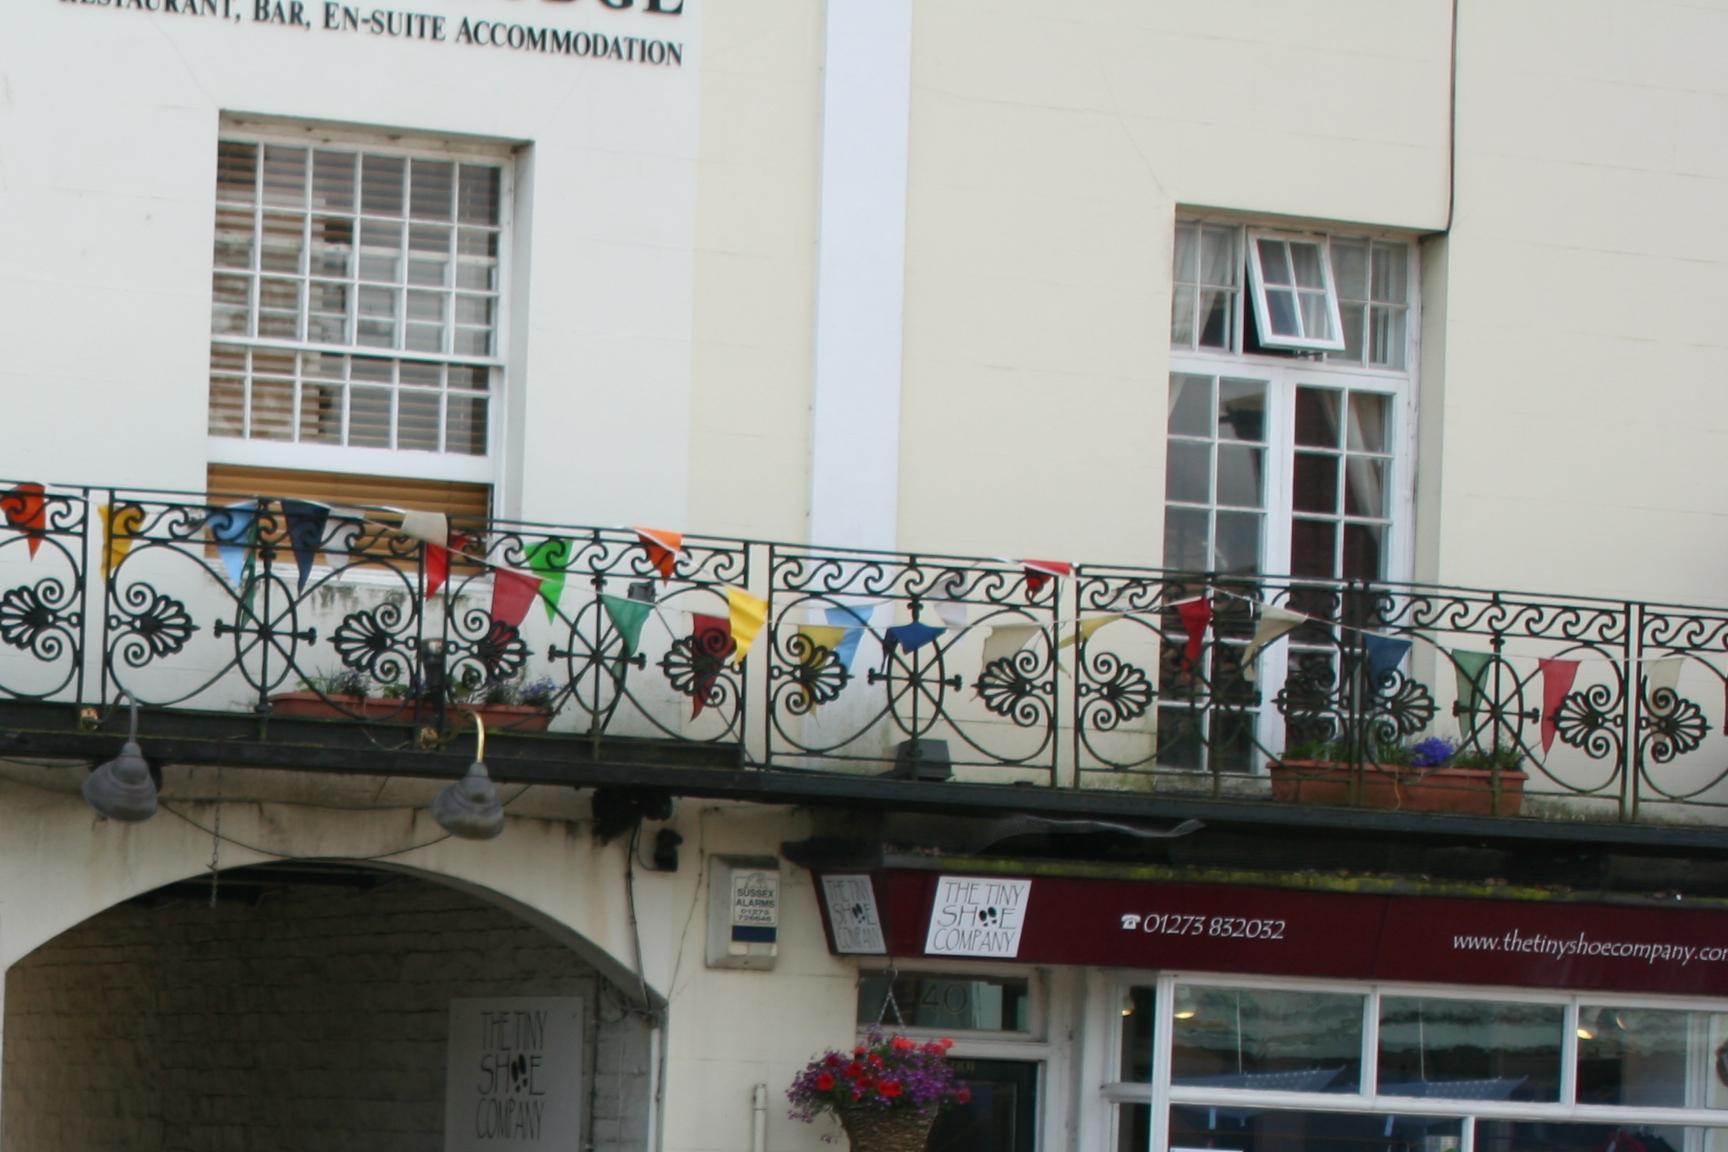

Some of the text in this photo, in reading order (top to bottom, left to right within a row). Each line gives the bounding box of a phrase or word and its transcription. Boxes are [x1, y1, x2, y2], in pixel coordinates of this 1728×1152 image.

[252, 0, 311, 31] BAR,
[322, 1, 447, 42] EN-SUITE
[455, 15, 684, 66] ACCOMMODATION
[944, 882, 1025, 906] THE TINY
[1143, 913, 1286, 939] 01273 832032
[933, 928, 1016, 953] COMPANY
[1452, 928, 1728, 966] www.thetinyshoecompany.co
